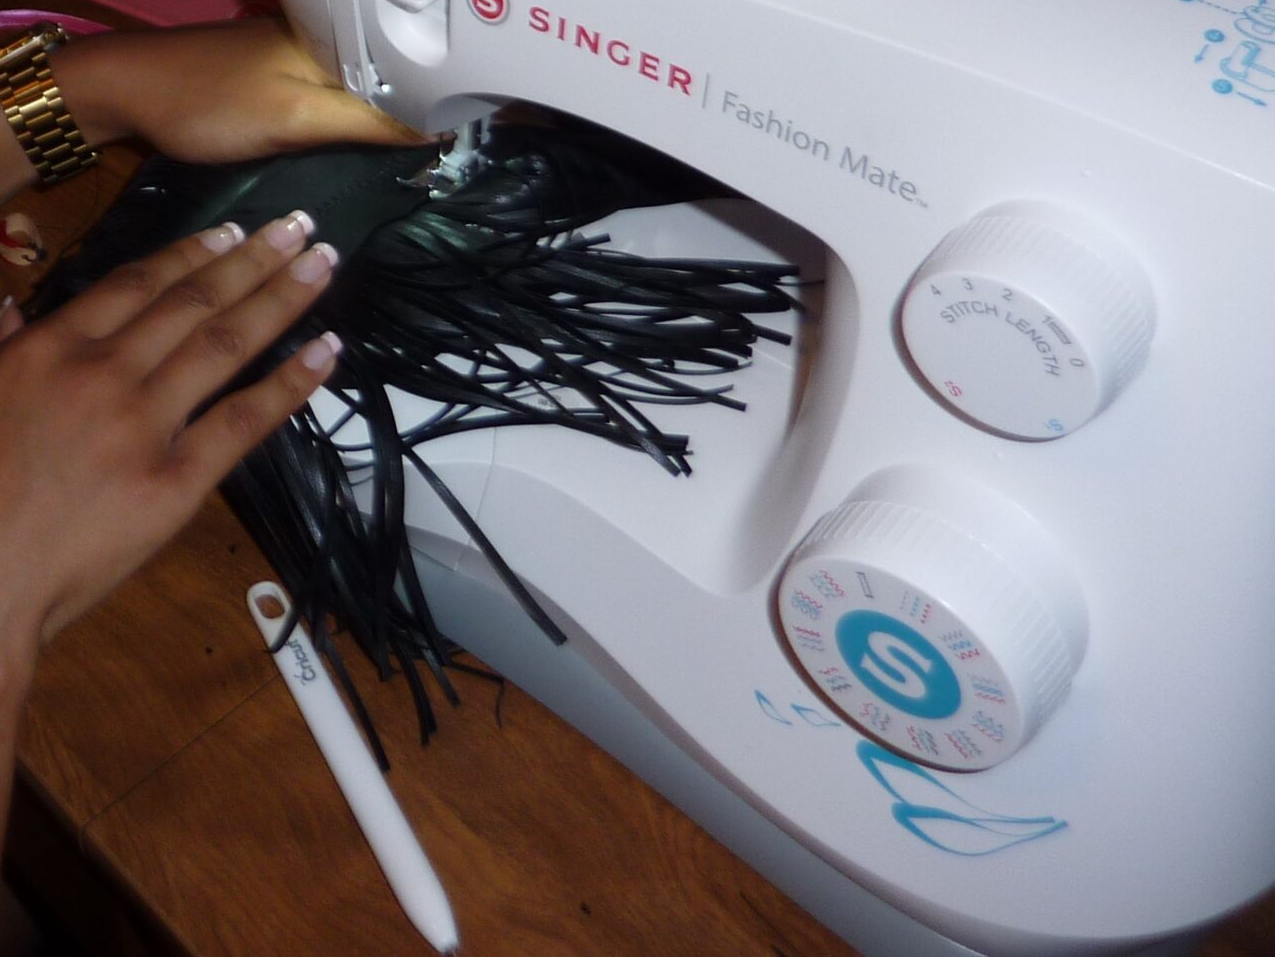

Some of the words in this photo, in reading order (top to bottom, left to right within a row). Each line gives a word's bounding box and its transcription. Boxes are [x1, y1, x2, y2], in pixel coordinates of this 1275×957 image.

[527, 4, 694, 96] SINGER
[721, 90, 831, 161] Fashion
[928, 284, 943, 297] 4
[961, 278, 974, 291] 3
[1001, 287, 1014, 301] 2
[1069, 358, 1084, 367] 0
[939, 300, 999, 324] STITCH
[1004, 311, 1061, 377] LENGTH
[860, 631, 932, 700] S
